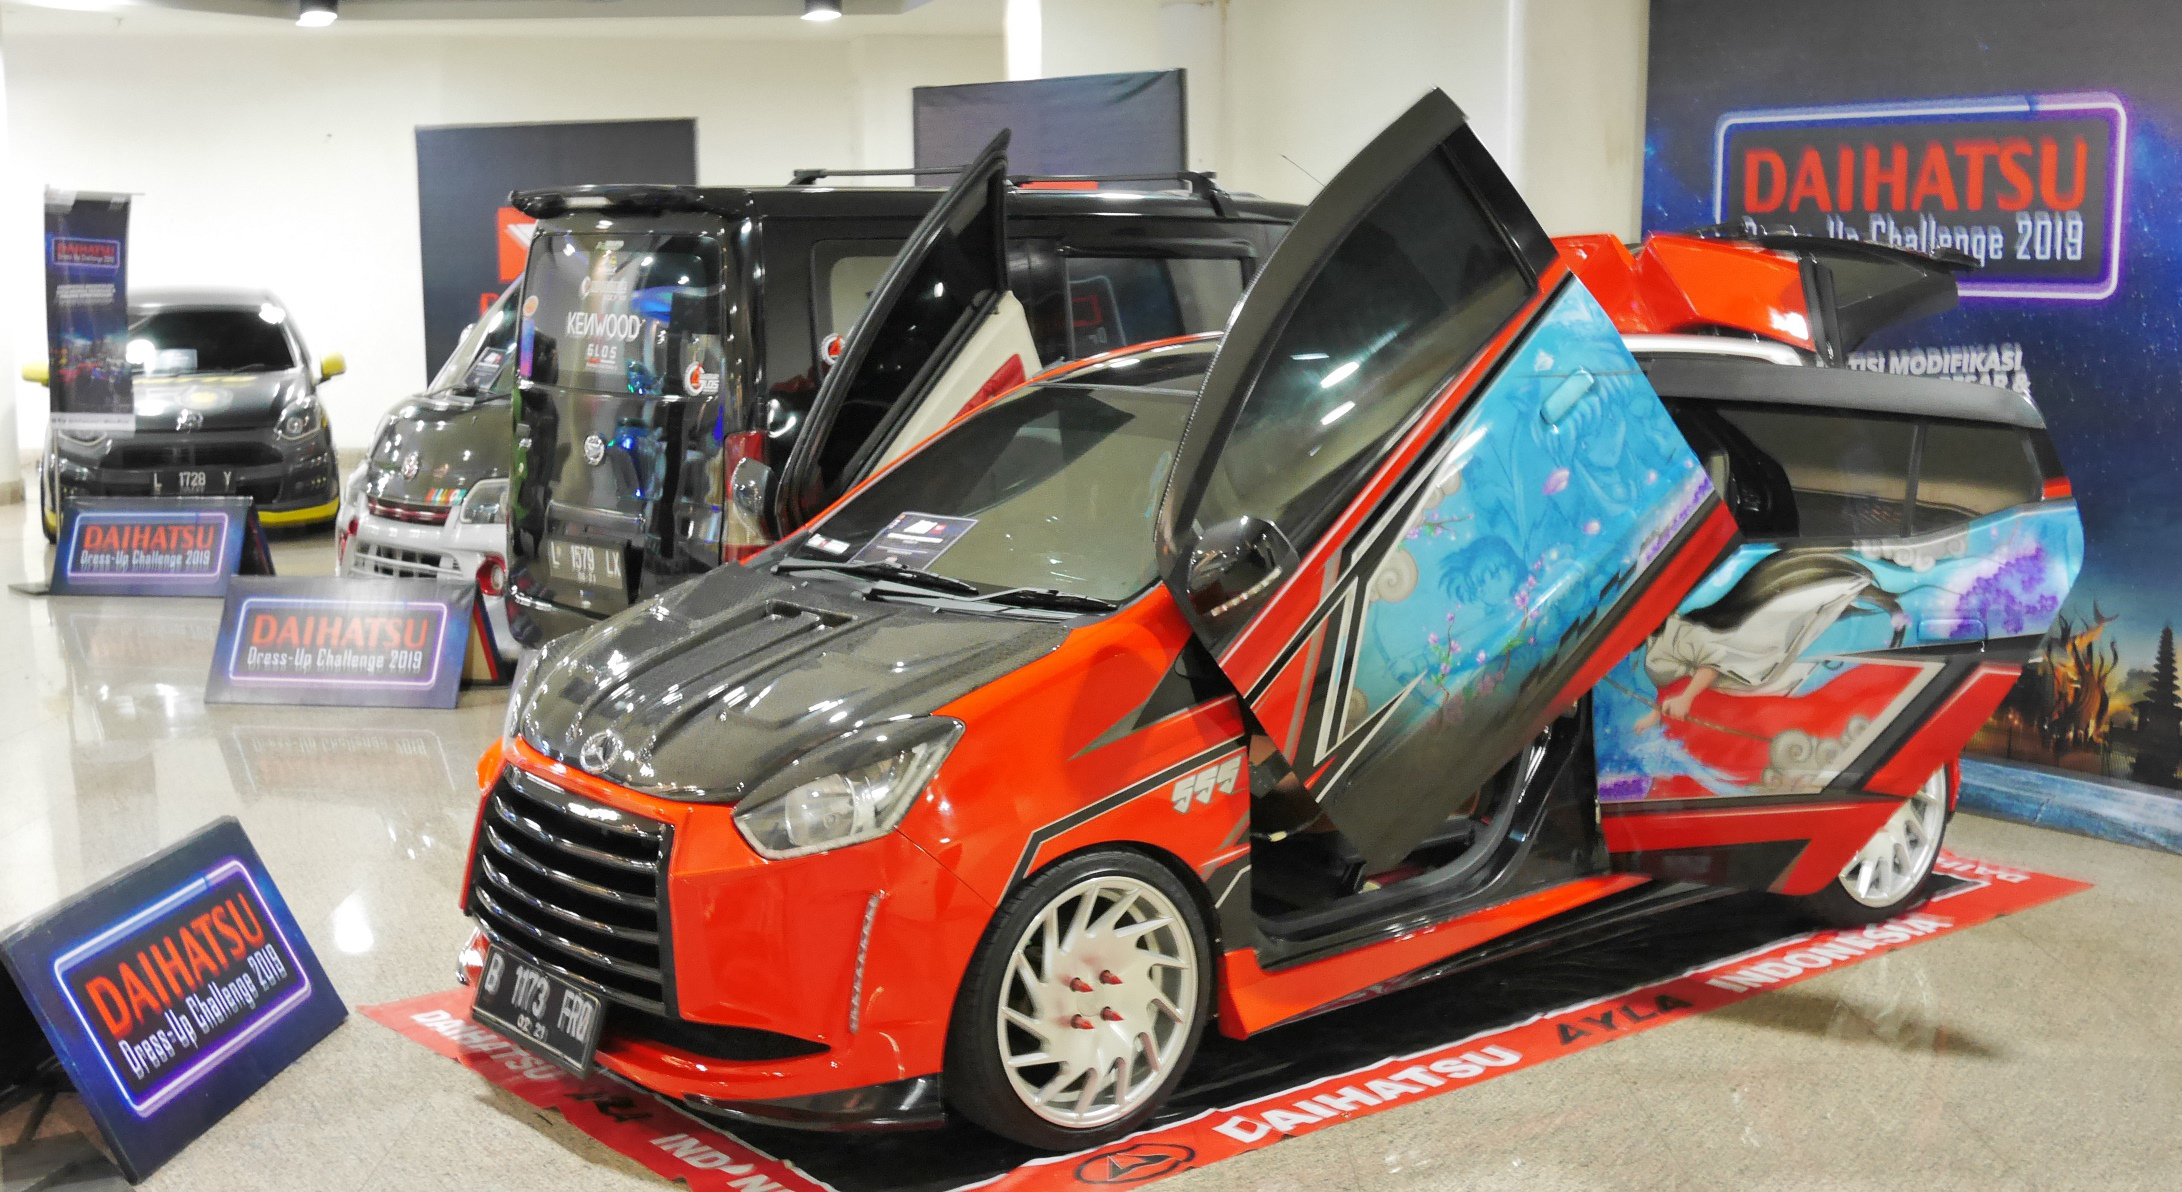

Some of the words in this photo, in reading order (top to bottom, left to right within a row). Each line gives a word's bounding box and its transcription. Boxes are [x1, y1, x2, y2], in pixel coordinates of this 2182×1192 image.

[1742, 134, 2089, 213] DAIHATSU
[2014, 211, 2084, 261] 2019
[567, 311, 641, 342] KENWOOD
[1889, 343, 2023, 375] MODIFIKASI
[153, 472, 163, 488] L
[223, 471, 232, 486] Y
[83, 524, 215, 551] DAIHATSU
[80, 549, 129, 570] Dress-Up
[132, 550, 182, 570] Challenge
[185, 550, 211, 567] 2019
[550, 541, 560, 566] L
[570, 544, 595, 571] 1579
[605, 550, 621, 577] LX
[252, 614, 429, 649] DAIHATSU
[247, 646, 312, 672] Dress-Up
[316, 648, 385, 673] Challenge
[389, 650, 423, 671] 2019
[85, 892, 267, 1040] DAIHATSU
[484, 952, 506, 995] B
[511, 965, 551, 1020] 1173
[118, 1008, 198, 1080] Dress-Up
[184, 976, 259, 1034] Challenge
[251, 943, 288, 992] 2019
[1211, 1044, 1523, 1143] DAIHATSU
[1556, 993, 1694, 1046] AYLA
[1705, 913, 1954, 994] INDONESIA
[410, 1009, 567, 1081] DAIHATSU
